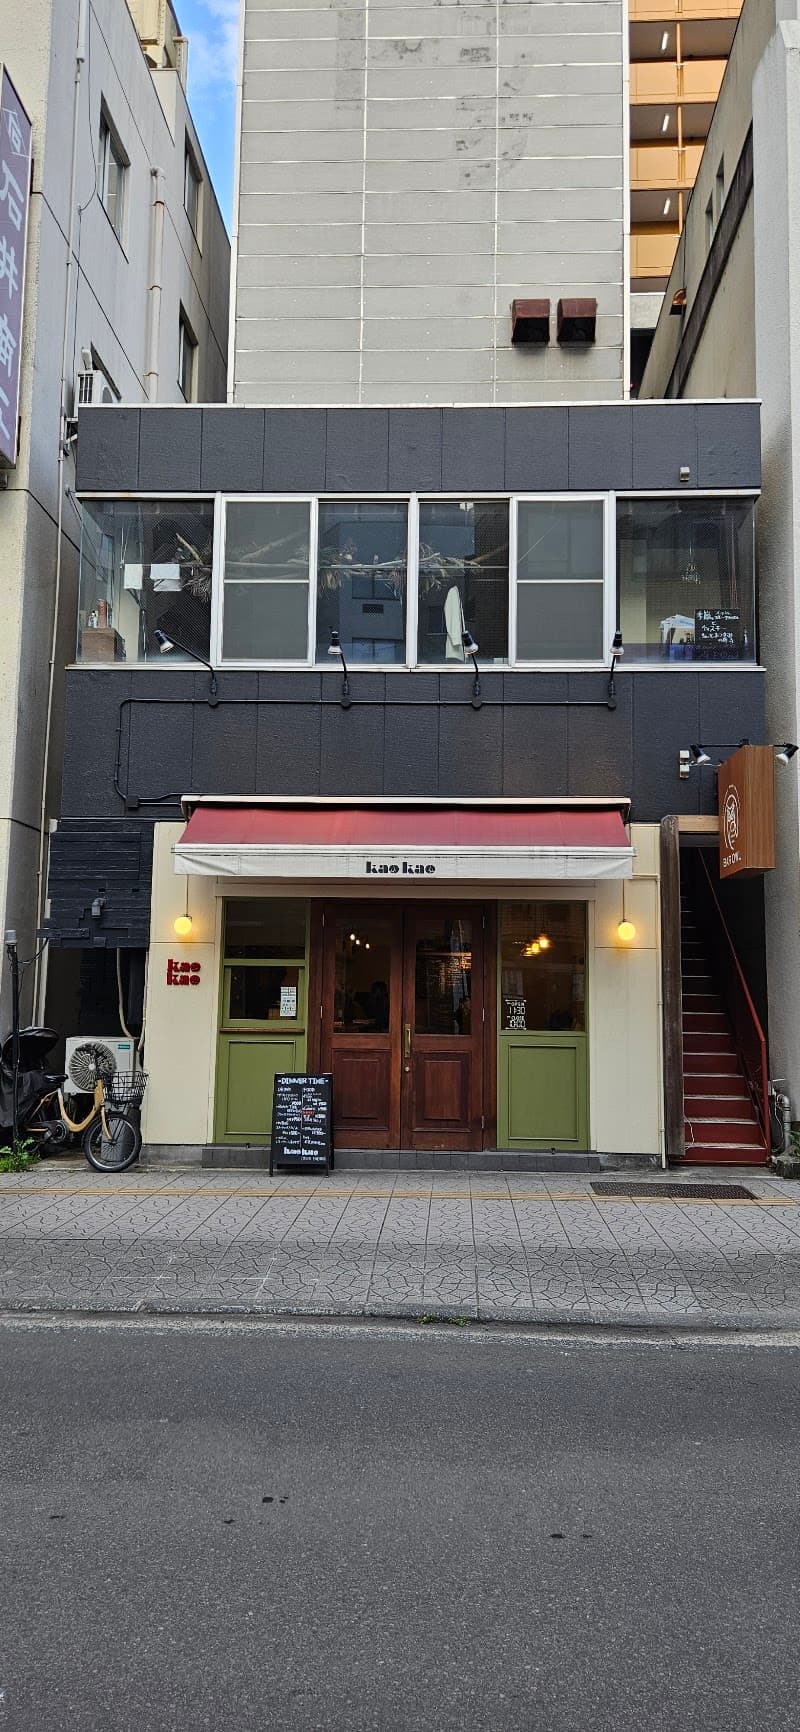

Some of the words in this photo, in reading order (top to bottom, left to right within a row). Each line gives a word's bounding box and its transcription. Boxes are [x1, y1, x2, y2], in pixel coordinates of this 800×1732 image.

[366, 861, 400, 874] kao
[402, 861, 436, 874] kao
[167, 959, 201, 972] kao
[166, 972, 201, 985] kao
